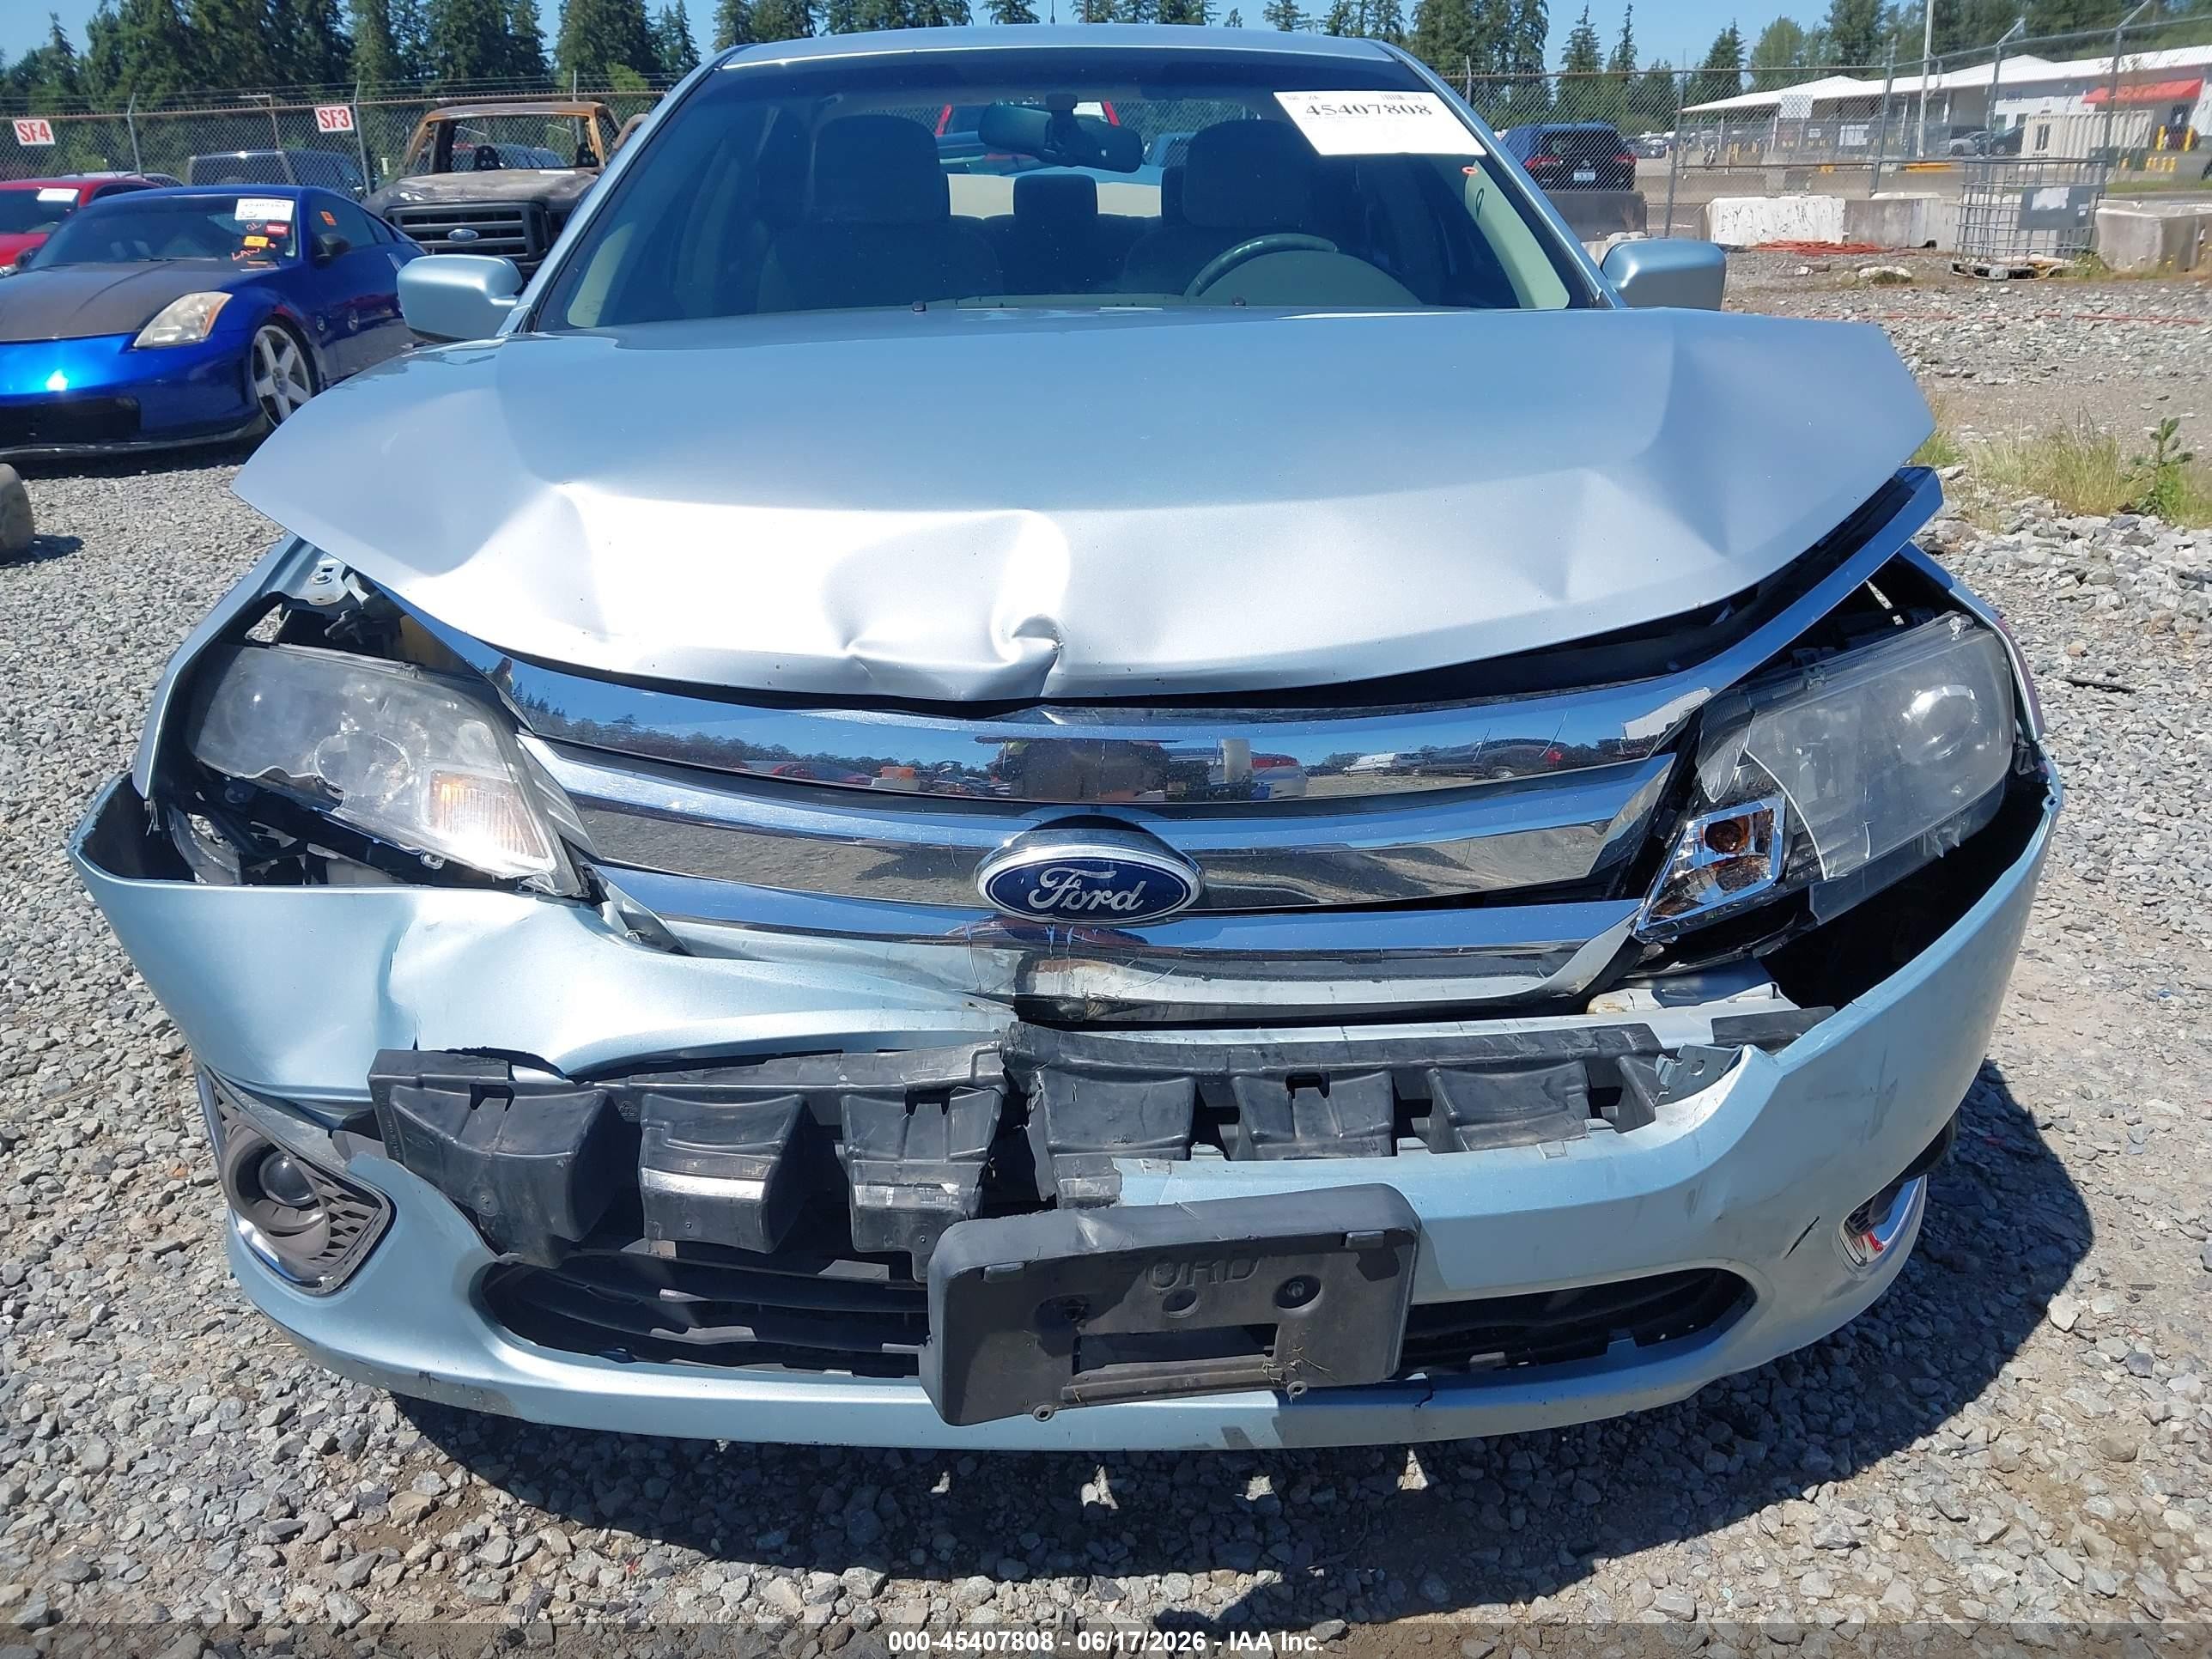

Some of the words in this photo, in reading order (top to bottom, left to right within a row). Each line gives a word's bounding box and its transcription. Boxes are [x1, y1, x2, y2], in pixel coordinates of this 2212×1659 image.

[319, 109, 349, 128] SF3
[1306, 104, 1431, 116] 45407808
[18, 122, 50, 142] SF4
[1028, 866, 1146, 911] Ford
[1119, 1255, 1260, 1291] ORD
